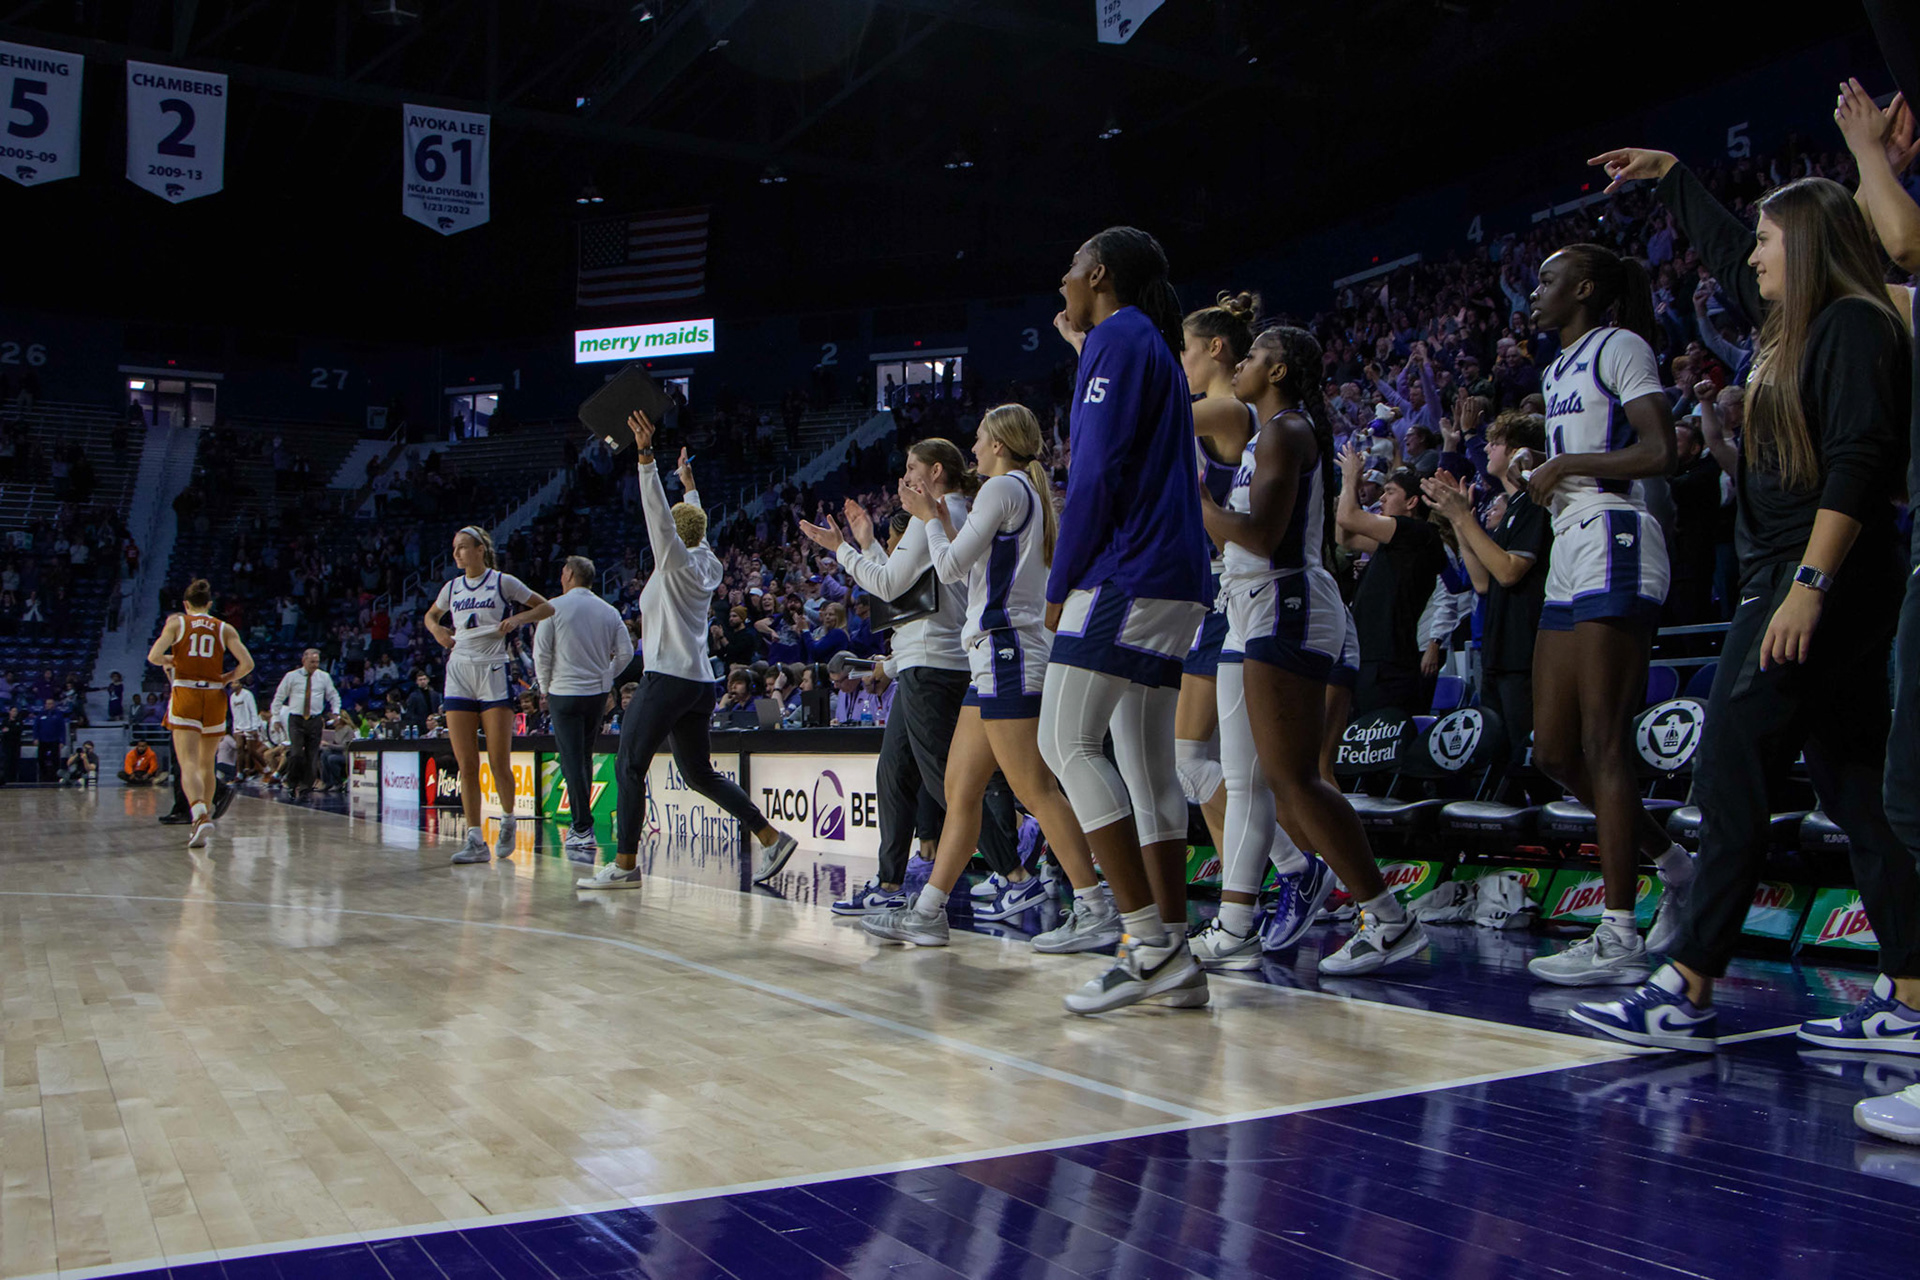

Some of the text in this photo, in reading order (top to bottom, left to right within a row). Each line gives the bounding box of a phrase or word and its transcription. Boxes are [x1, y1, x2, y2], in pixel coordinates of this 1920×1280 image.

[132, 73, 223, 97] CHAMBERS
[7, 77, 49, 138] 5
[157, 98, 196, 158] 2
[409, 116, 485, 136] AYOKA LEE
[1727, 121, 1752, 158] 5
[0, 145, 57, 163] 2005-09
[414, 134, 471, 186] 61
[148, 164, 203, 180] 2009-13
[407, 184, 433, 194] NCAA
[436, 187, 477, 199] DIVISION
[423, 202, 470, 214] 1/23/2022
[1467, 215, 1485, 244] 4
[579, 326, 709, 353] merry maids
[1021, 327, 1040, 352] 3
[2, 342, 46, 366] 26
[821, 342, 838, 366] 2
[310, 367, 349, 391] 27
[512, 369, 522, 391] 1
[1083, 376, 1110, 404] 15
[452, 597, 495, 612] Wildcats
[188, 633, 215, 658] 10
[1342, 718, 1406, 745] Capitol
[1335, 739, 1398, 764] Federal
[437, 768, 456, 797] Pizza
[665, 804, 687, 834] Via
[763, 788, 877, 828] TACO BE
